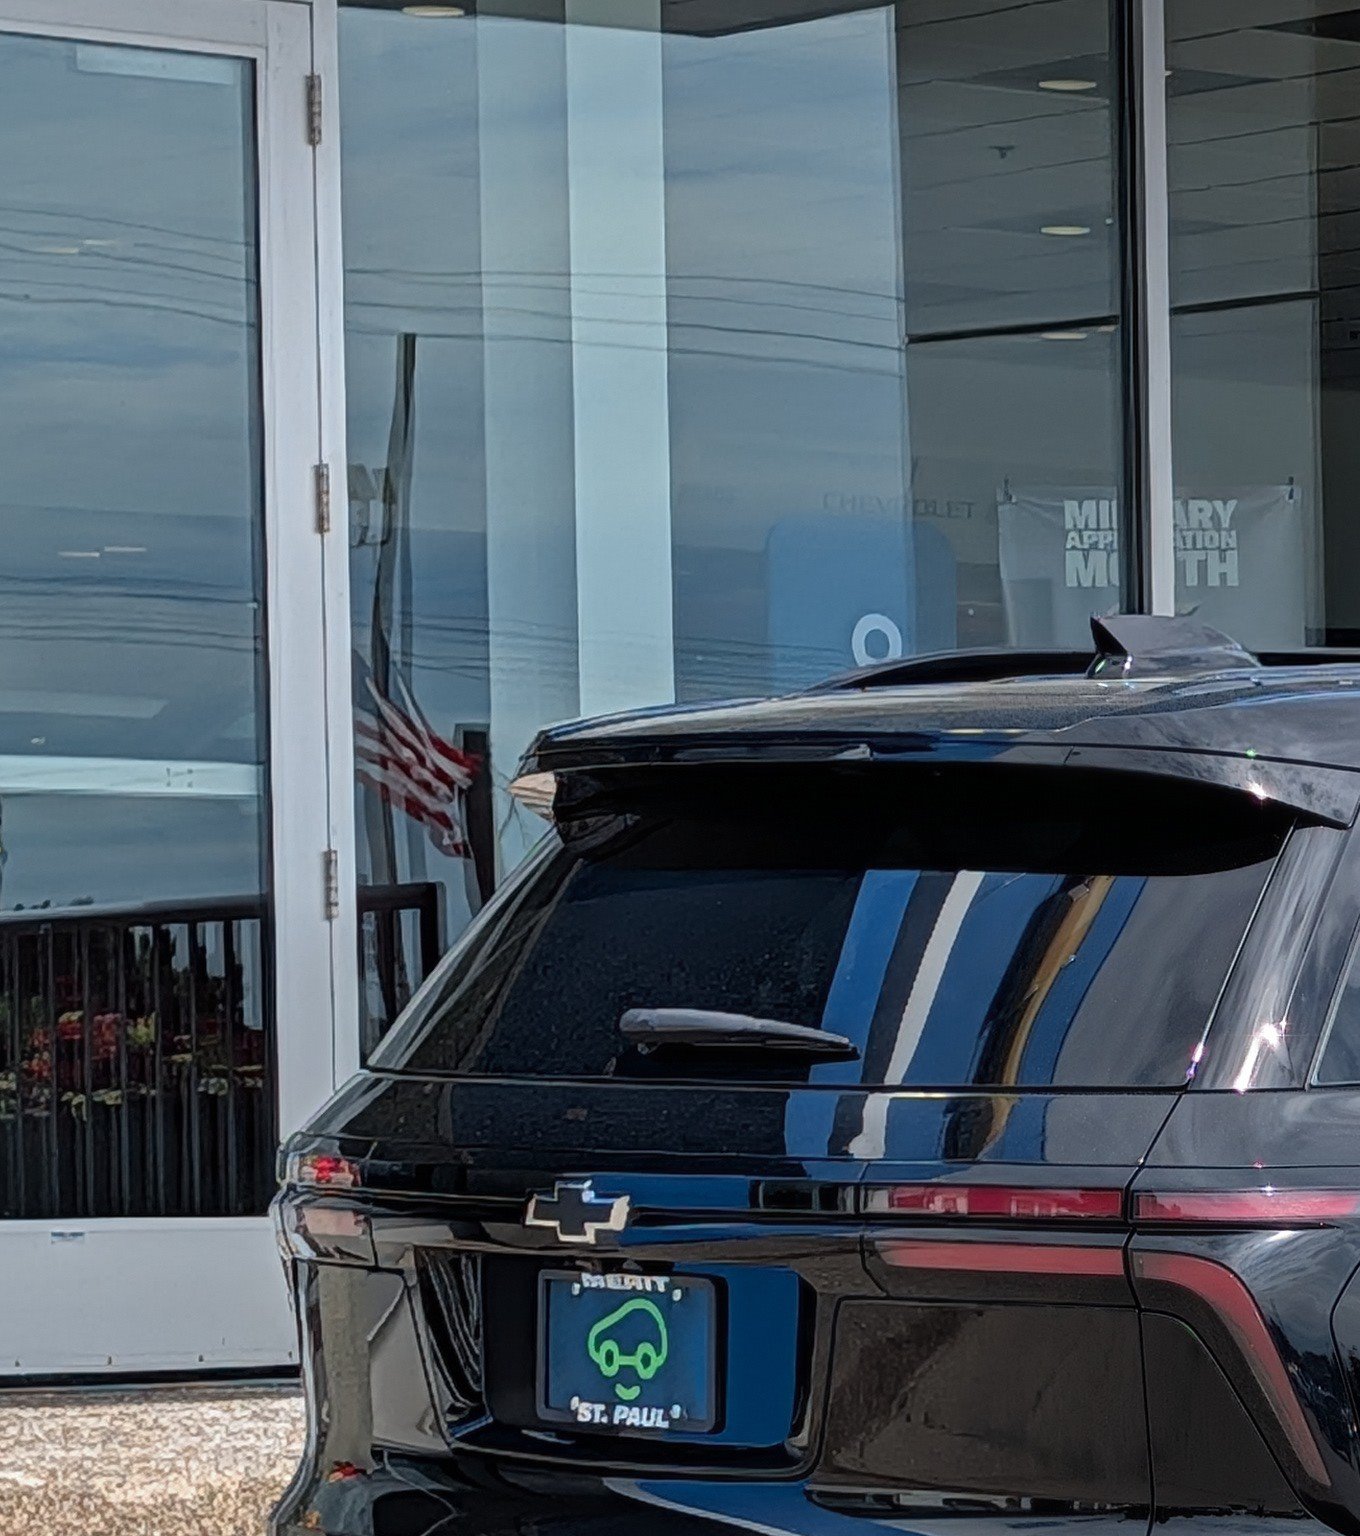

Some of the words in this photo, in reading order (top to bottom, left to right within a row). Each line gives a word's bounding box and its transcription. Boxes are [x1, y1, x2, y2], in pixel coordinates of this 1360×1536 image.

[1066, 550, 1239, 587] MTH
[576, 1402, 609, 1424] ST.
[613, 1404, 670, 1429] PAUL
